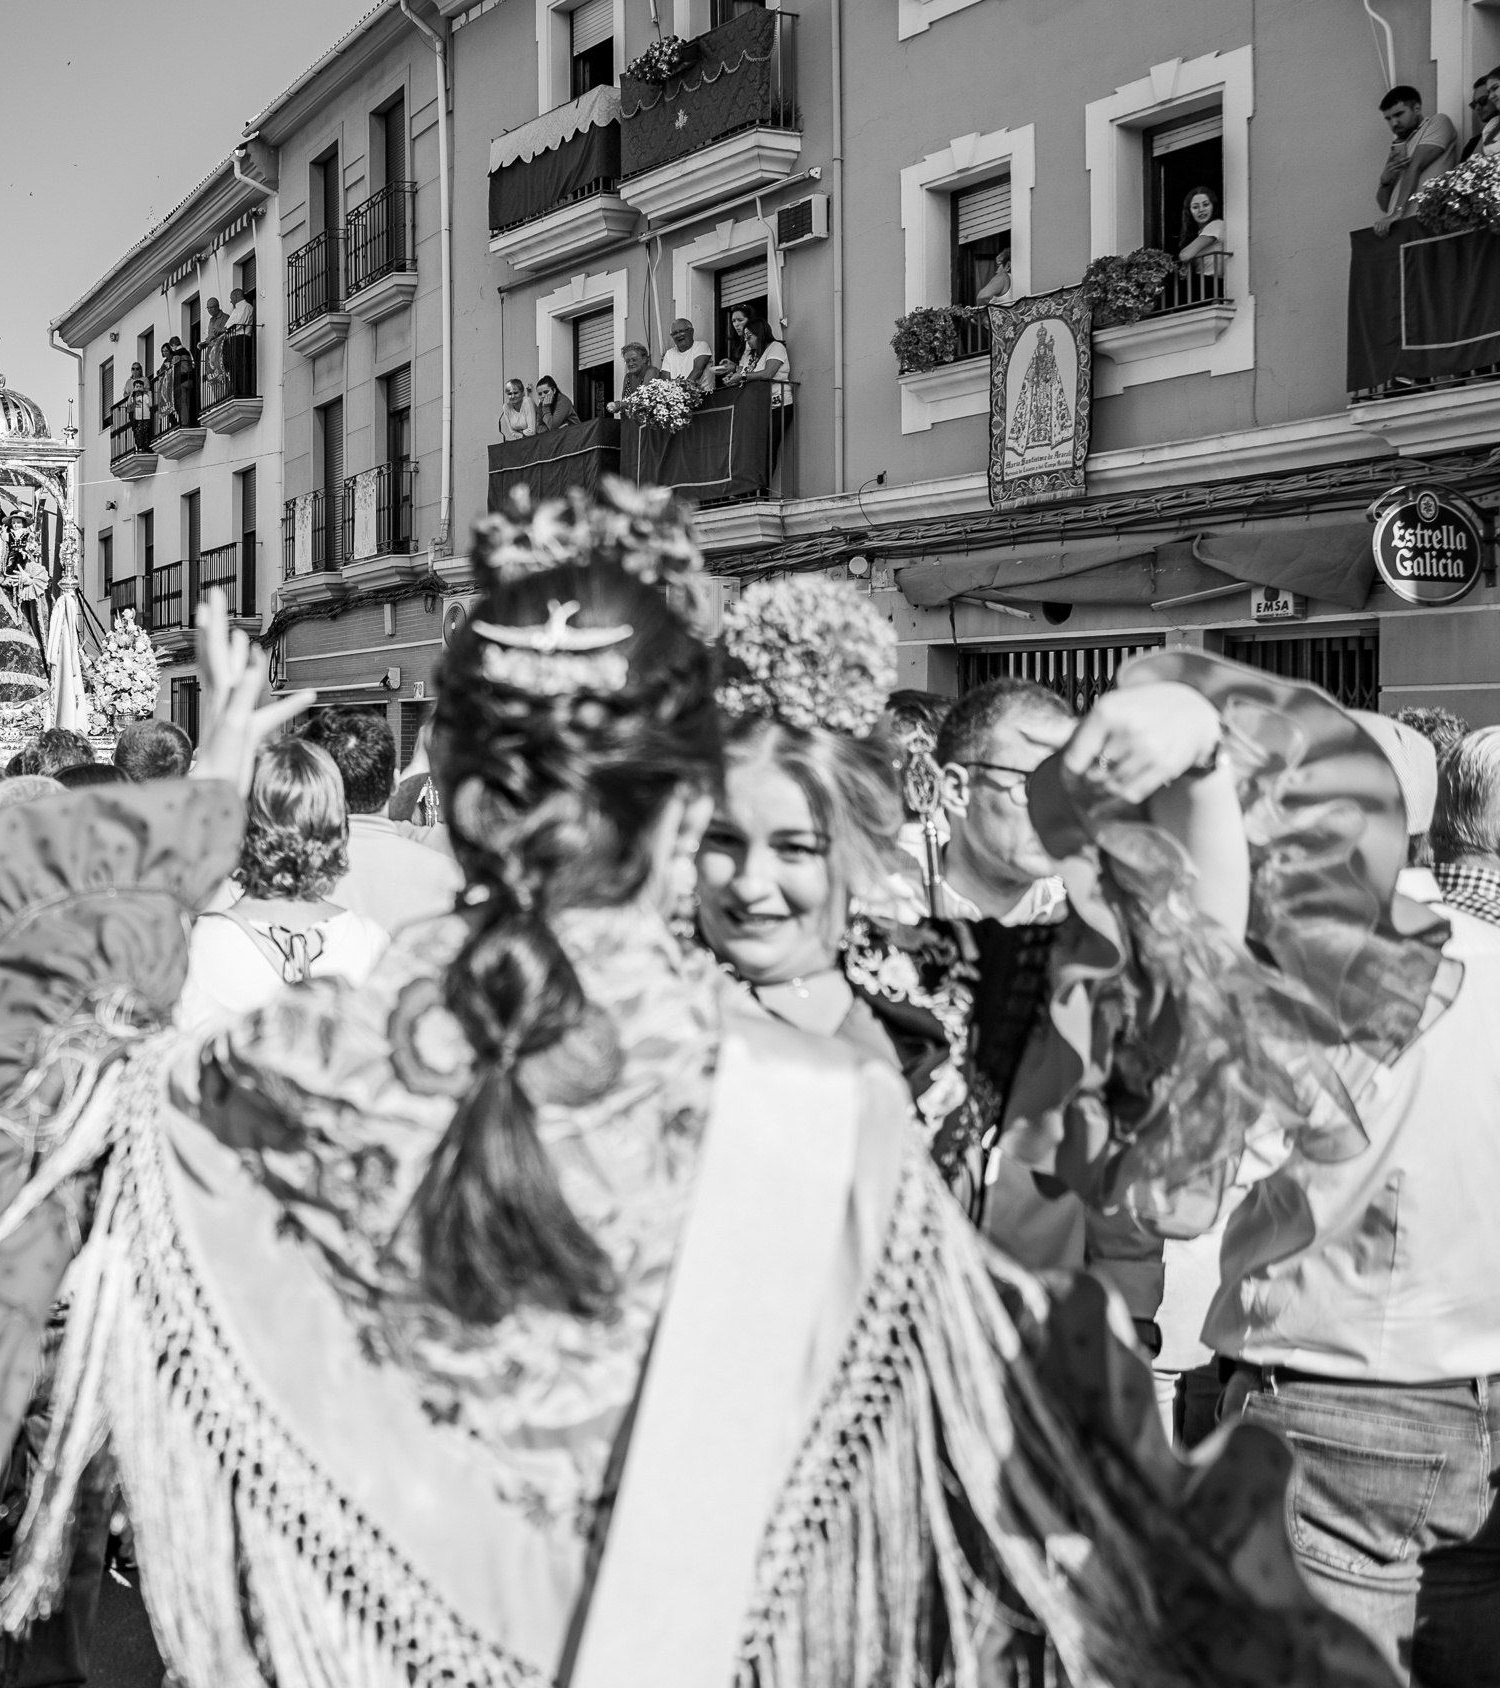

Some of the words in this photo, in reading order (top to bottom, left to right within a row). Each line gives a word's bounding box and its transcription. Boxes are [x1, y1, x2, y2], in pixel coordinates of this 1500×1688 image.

[1391, 520, 1468, 551] Estrella
[1395, 548, 1465, 578] Galicia
[1256, 599, 1289, 613] EMSA
